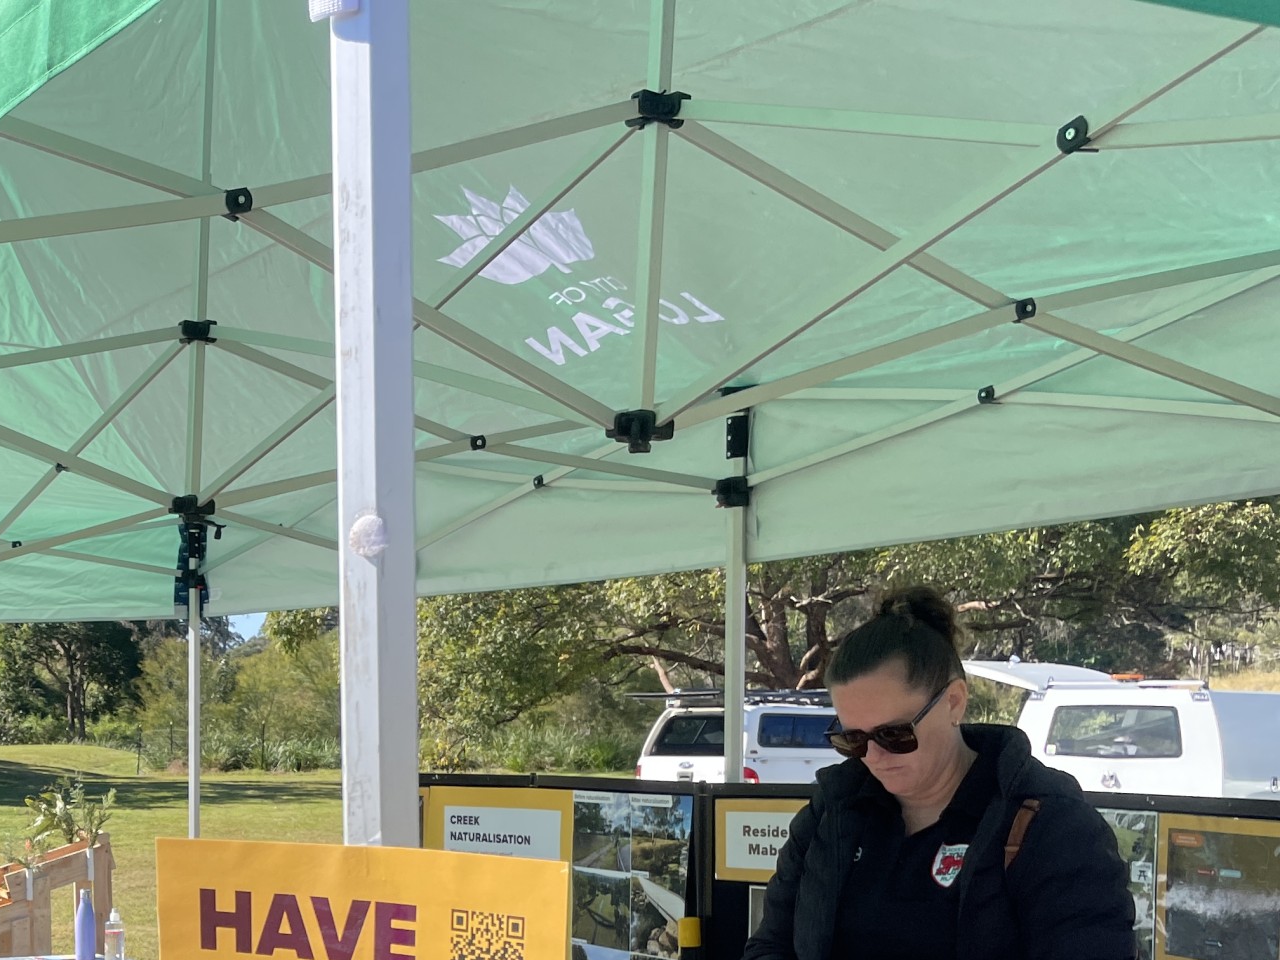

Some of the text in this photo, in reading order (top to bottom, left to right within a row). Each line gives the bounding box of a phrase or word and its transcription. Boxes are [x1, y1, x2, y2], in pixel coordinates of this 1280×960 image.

[450, 815, 480, 827] CREEK
[450, 831, 531, 846] NATURALISATION
[748, 843, 780, 856] Mab
